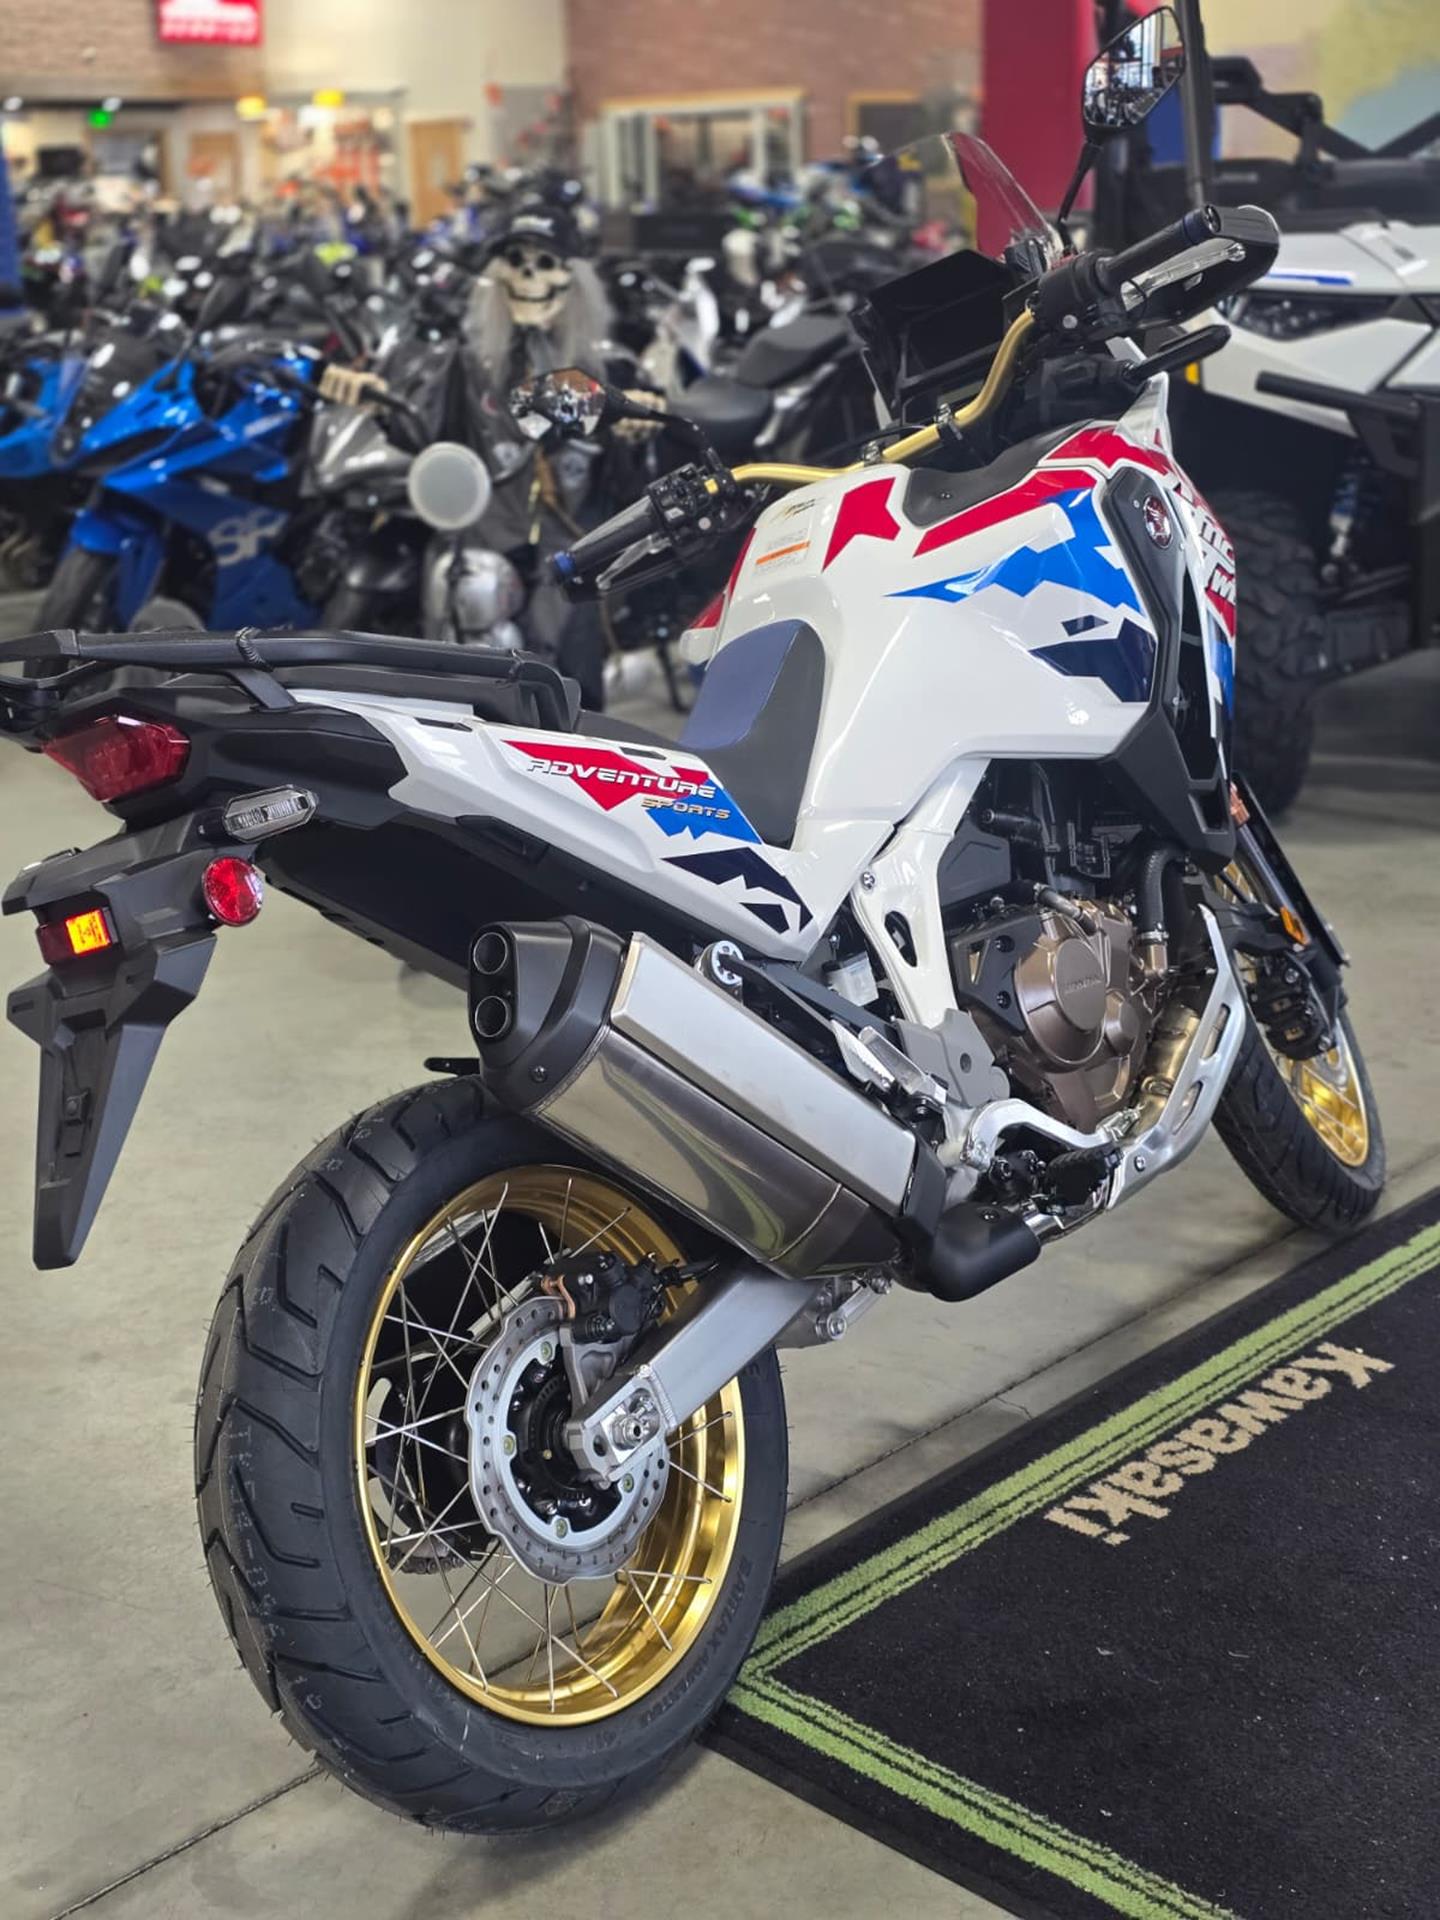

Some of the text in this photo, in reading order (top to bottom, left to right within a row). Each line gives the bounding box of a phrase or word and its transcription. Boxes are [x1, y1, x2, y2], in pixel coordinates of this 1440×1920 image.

[527, 760, 718, 798] ADVENTURE
[641, 797, 731, 819] SPORTS
[1044, 1342, 1395, 1545] Kawasaki
